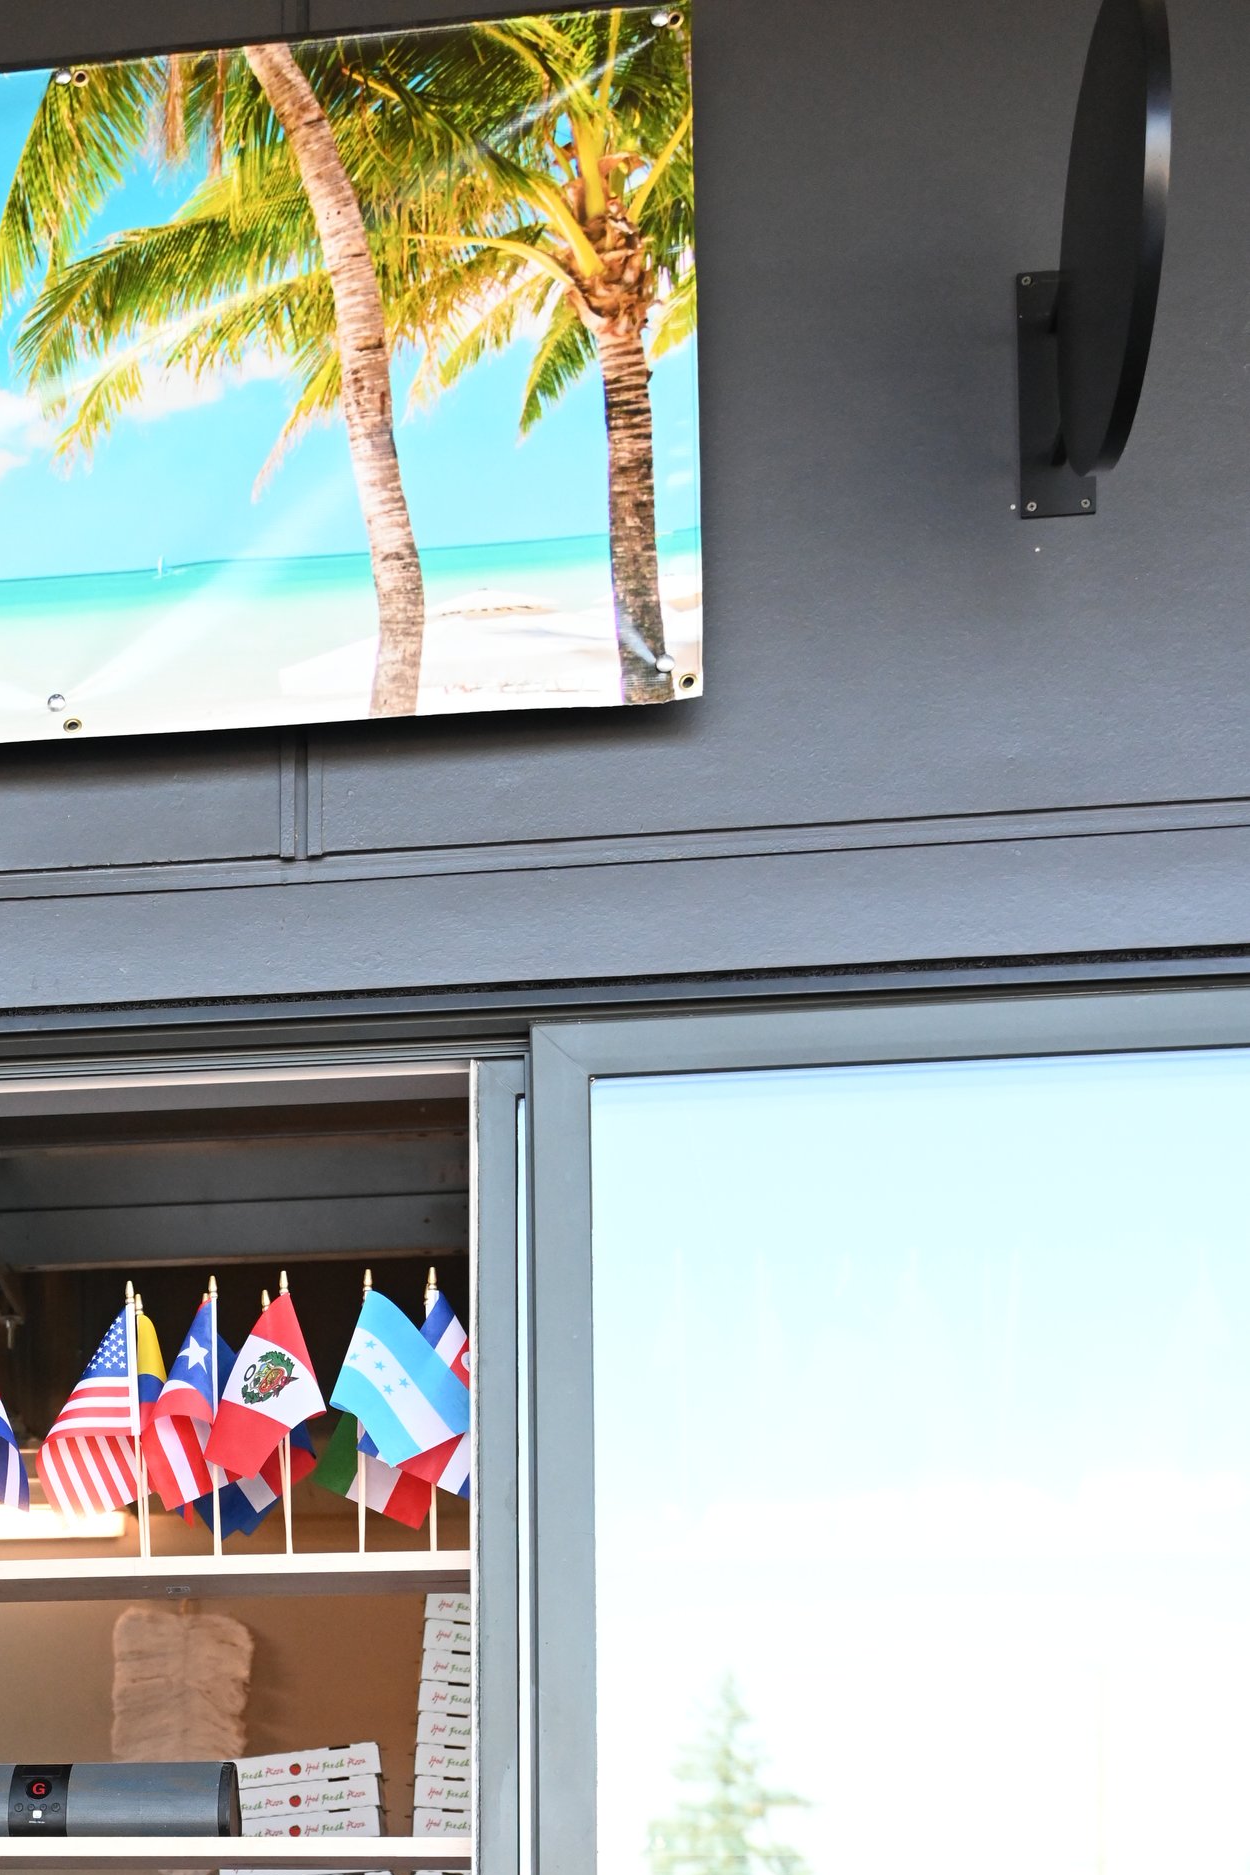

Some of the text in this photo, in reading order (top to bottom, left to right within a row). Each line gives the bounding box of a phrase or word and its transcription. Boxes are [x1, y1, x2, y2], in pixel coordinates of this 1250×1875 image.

[347, 1758, 366, 1767] Pizza
[265, 1768, 284, 1777] Pizza
[32, 1782, 46, 1795] G
